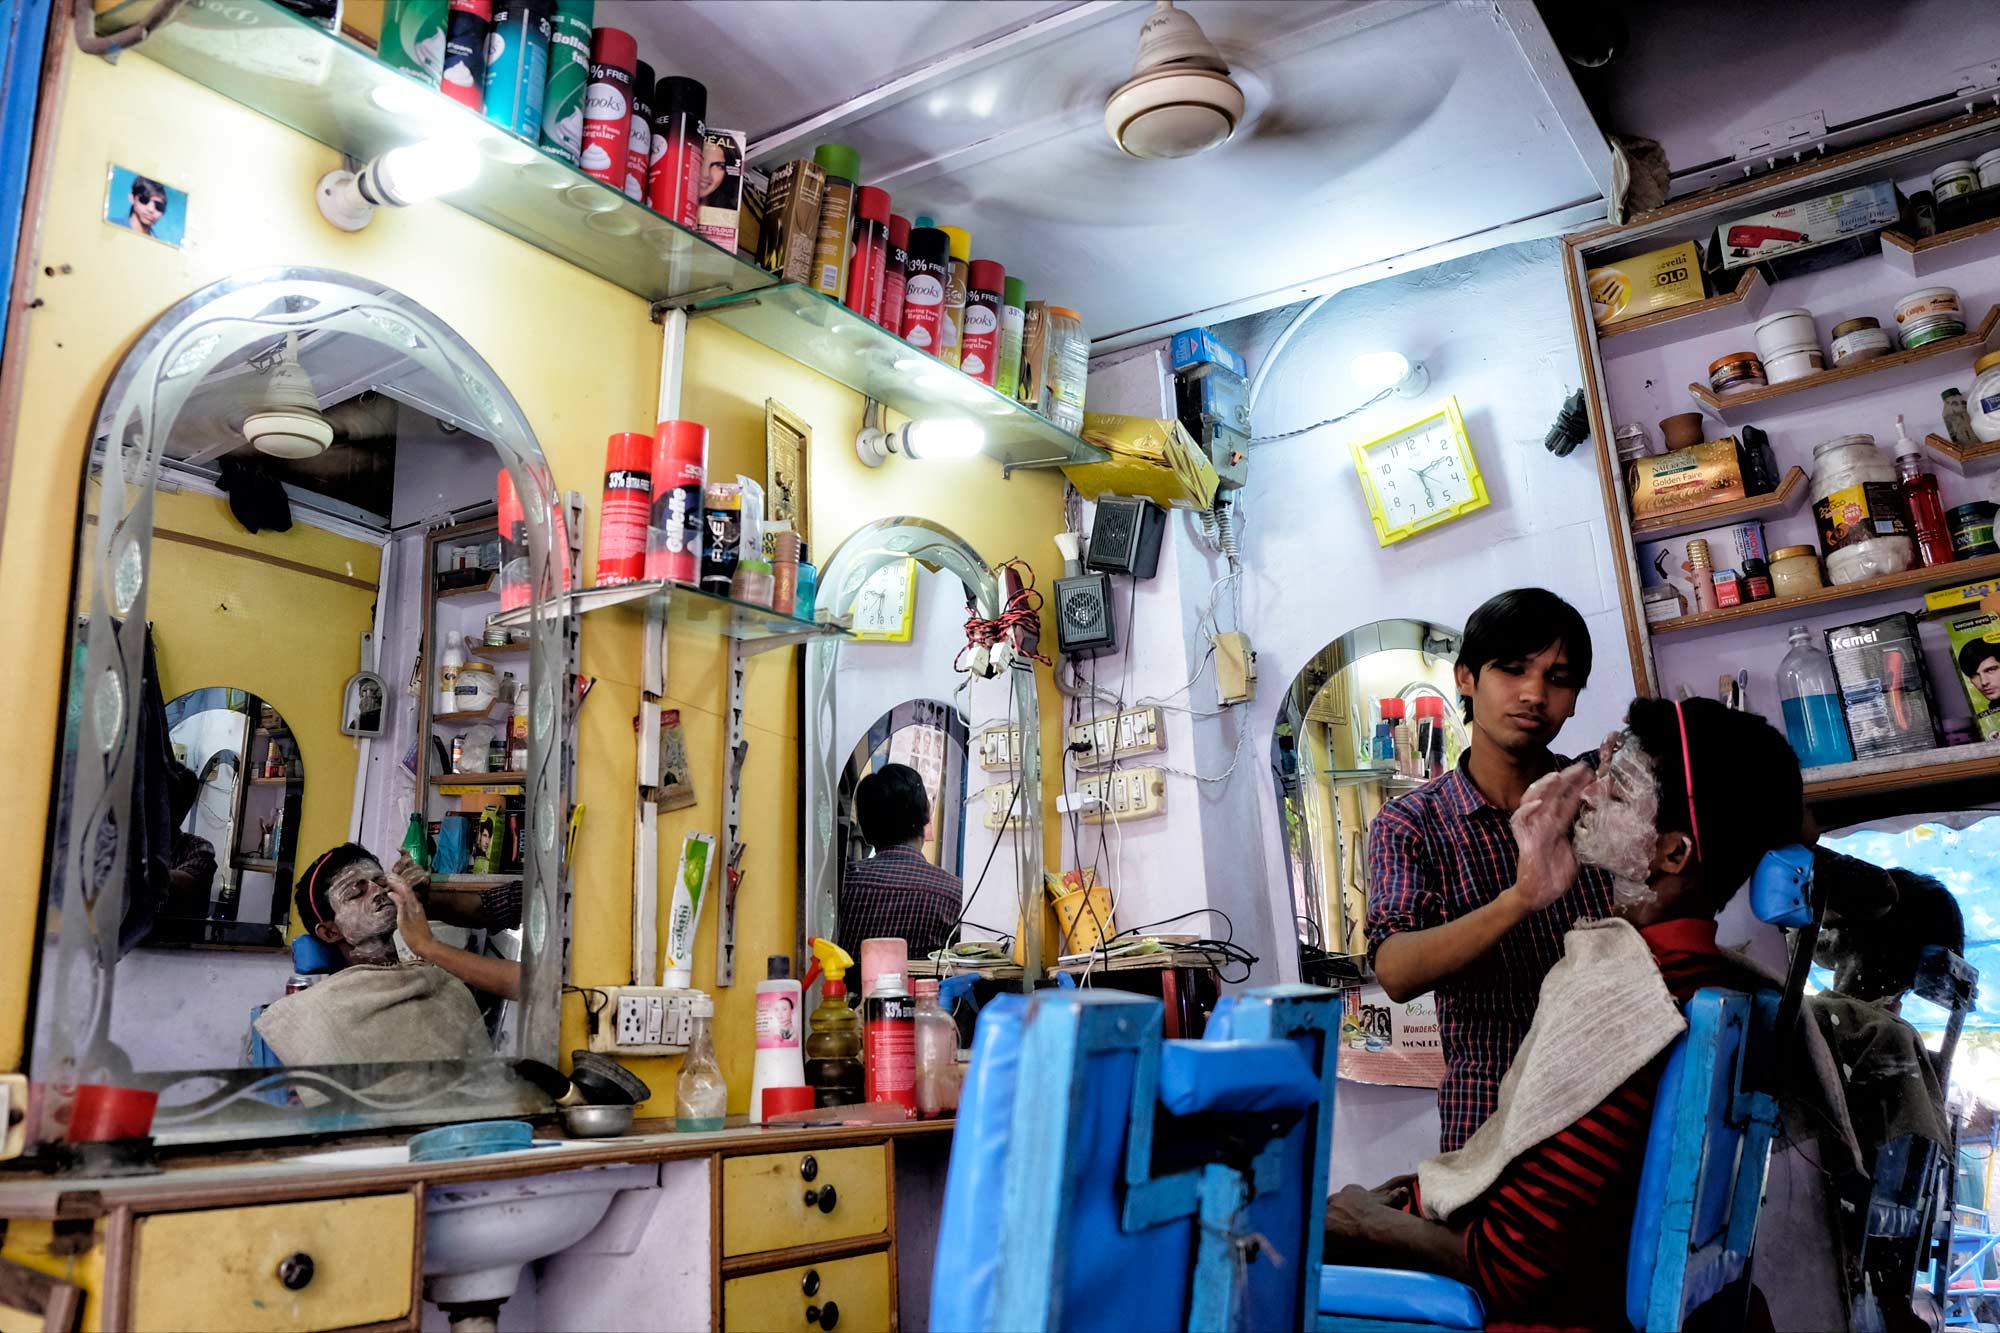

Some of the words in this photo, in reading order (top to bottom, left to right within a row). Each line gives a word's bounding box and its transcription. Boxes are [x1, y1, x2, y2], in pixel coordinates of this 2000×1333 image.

[606, 68, 629, 84] FREE
[906, 283, 940, 299] Brooks
[980, 292, 999, 303] FREE
[1406, 439, 1417, 451] 12
[1440, 439, 1448, 451] 2
[1390, 446, 1399, 459] 11
[1445, 455, 1455, 468] 3
[1381, 463, 1392, 476] 10
[1451, 472, 1460, 483] 4
[1652, 476, 1681, 488] Golden
[1682, 471, 1704, 481] Faire
[1388, 480, 1397, 490] 9
[1393, 496, 1401, 508] 8
[1442, 489, 1452, 502] 5
[1409, 503, 1417, 515] 7
[711, 521, 726, 563] AXE
